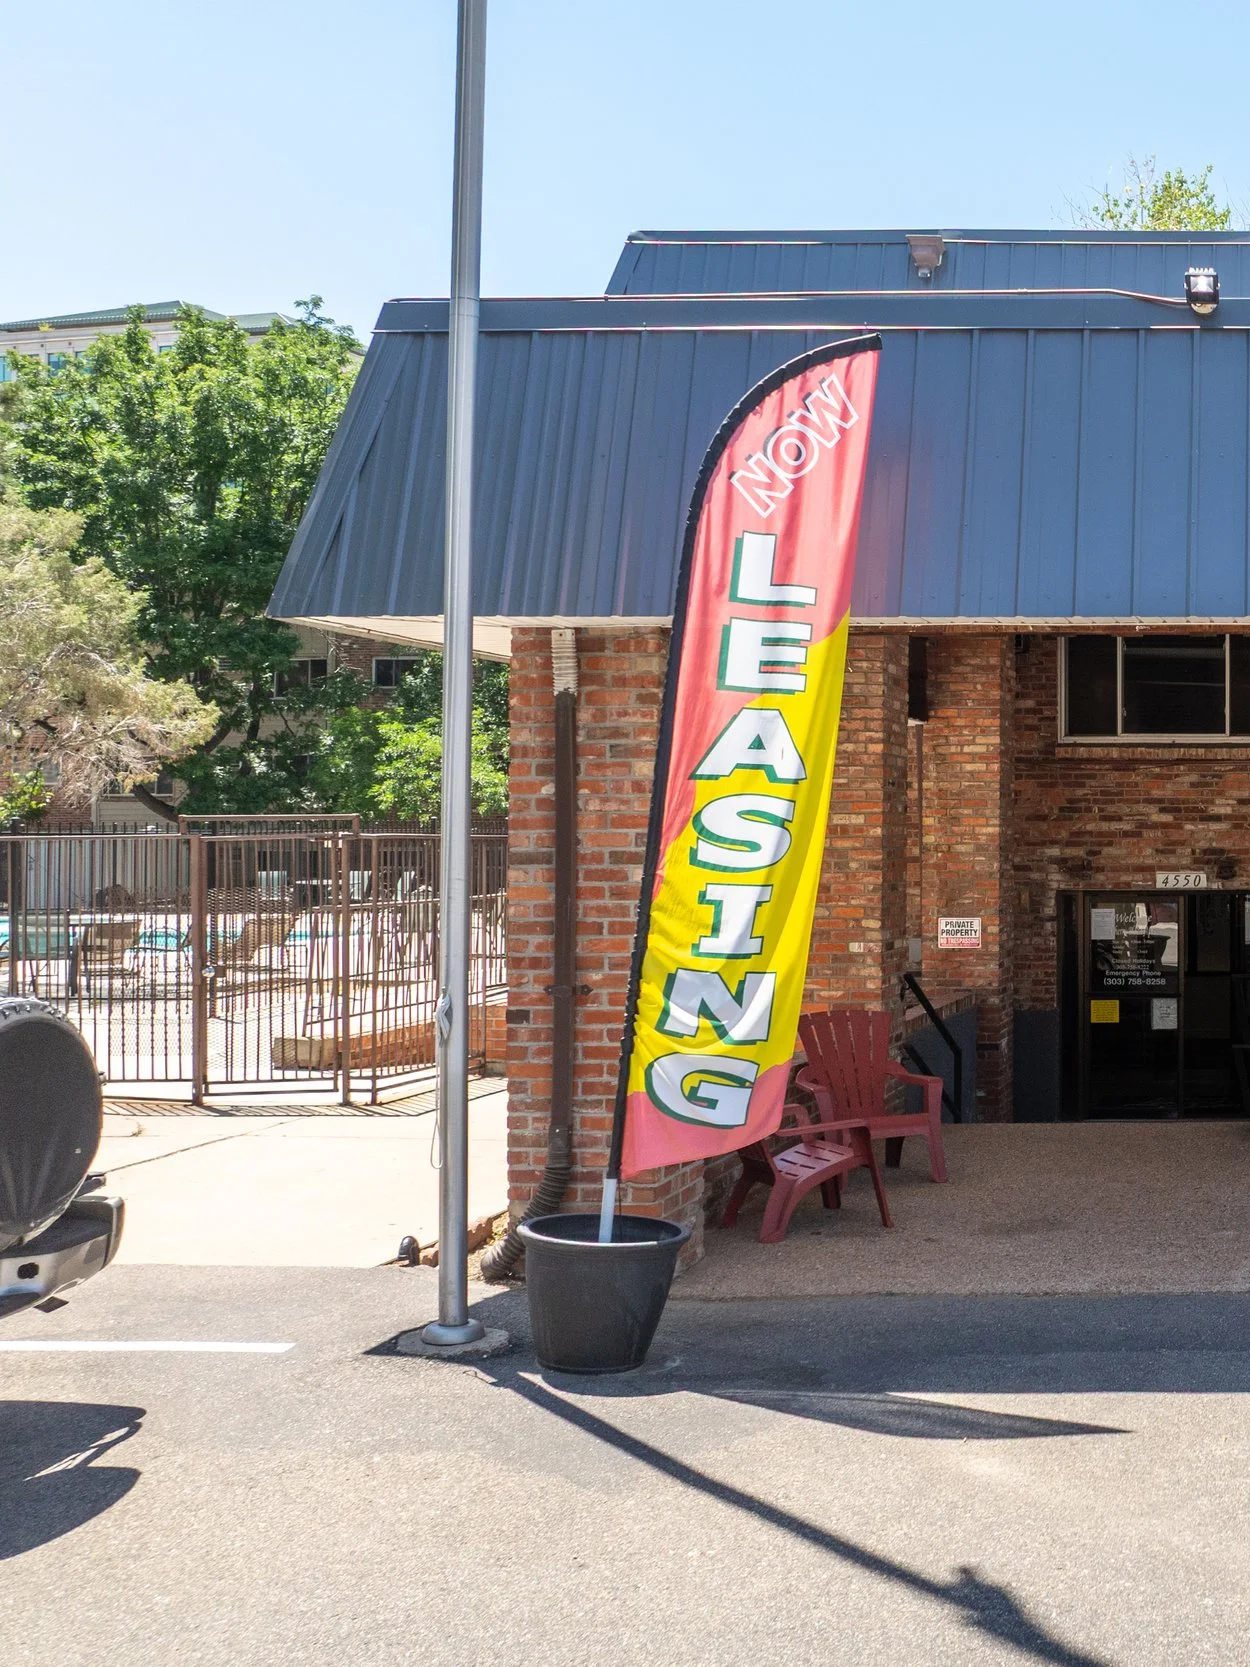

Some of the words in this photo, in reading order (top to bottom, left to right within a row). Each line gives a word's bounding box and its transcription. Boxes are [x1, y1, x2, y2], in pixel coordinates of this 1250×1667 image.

[728, 373, 859, 519] NOW
[645, 530, 818, 1130] LEASING
[1162, 875, 1201, 887] 4550
[1103, 978, 1125, 986] (303)
